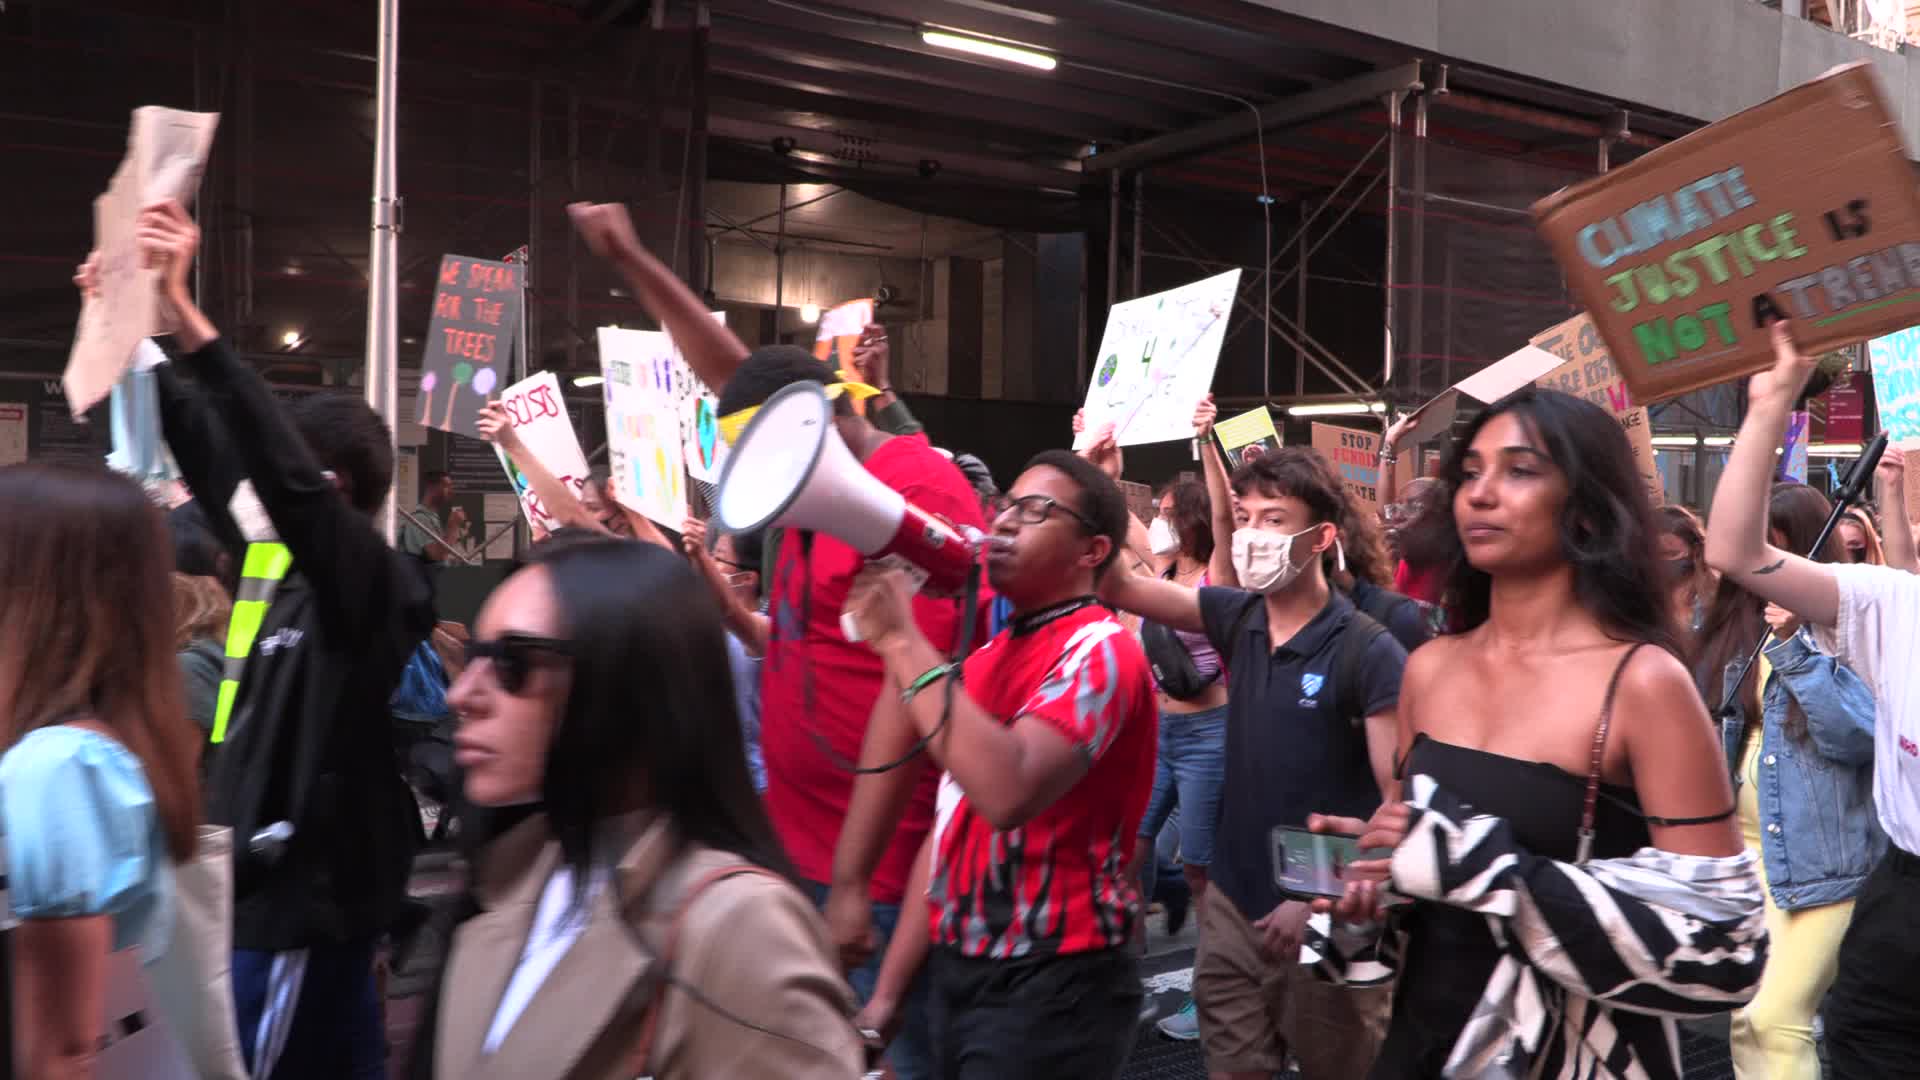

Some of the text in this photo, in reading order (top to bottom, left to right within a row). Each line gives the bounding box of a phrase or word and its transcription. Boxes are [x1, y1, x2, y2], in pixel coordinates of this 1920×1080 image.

[1576, 166, 1757, 268] CLIMATE
[440, 262, 461, 285] WE
[1604, 200, 1870, 313] JUSTICE IS
[434, 292, 504, 326] FOR THE
[443, 327, 498, 362] TREES
[1631, 303, 1738, 365] NOT
[1752, 293, 1788, 329] A
[1341, 432, 1372, 450] STOP
